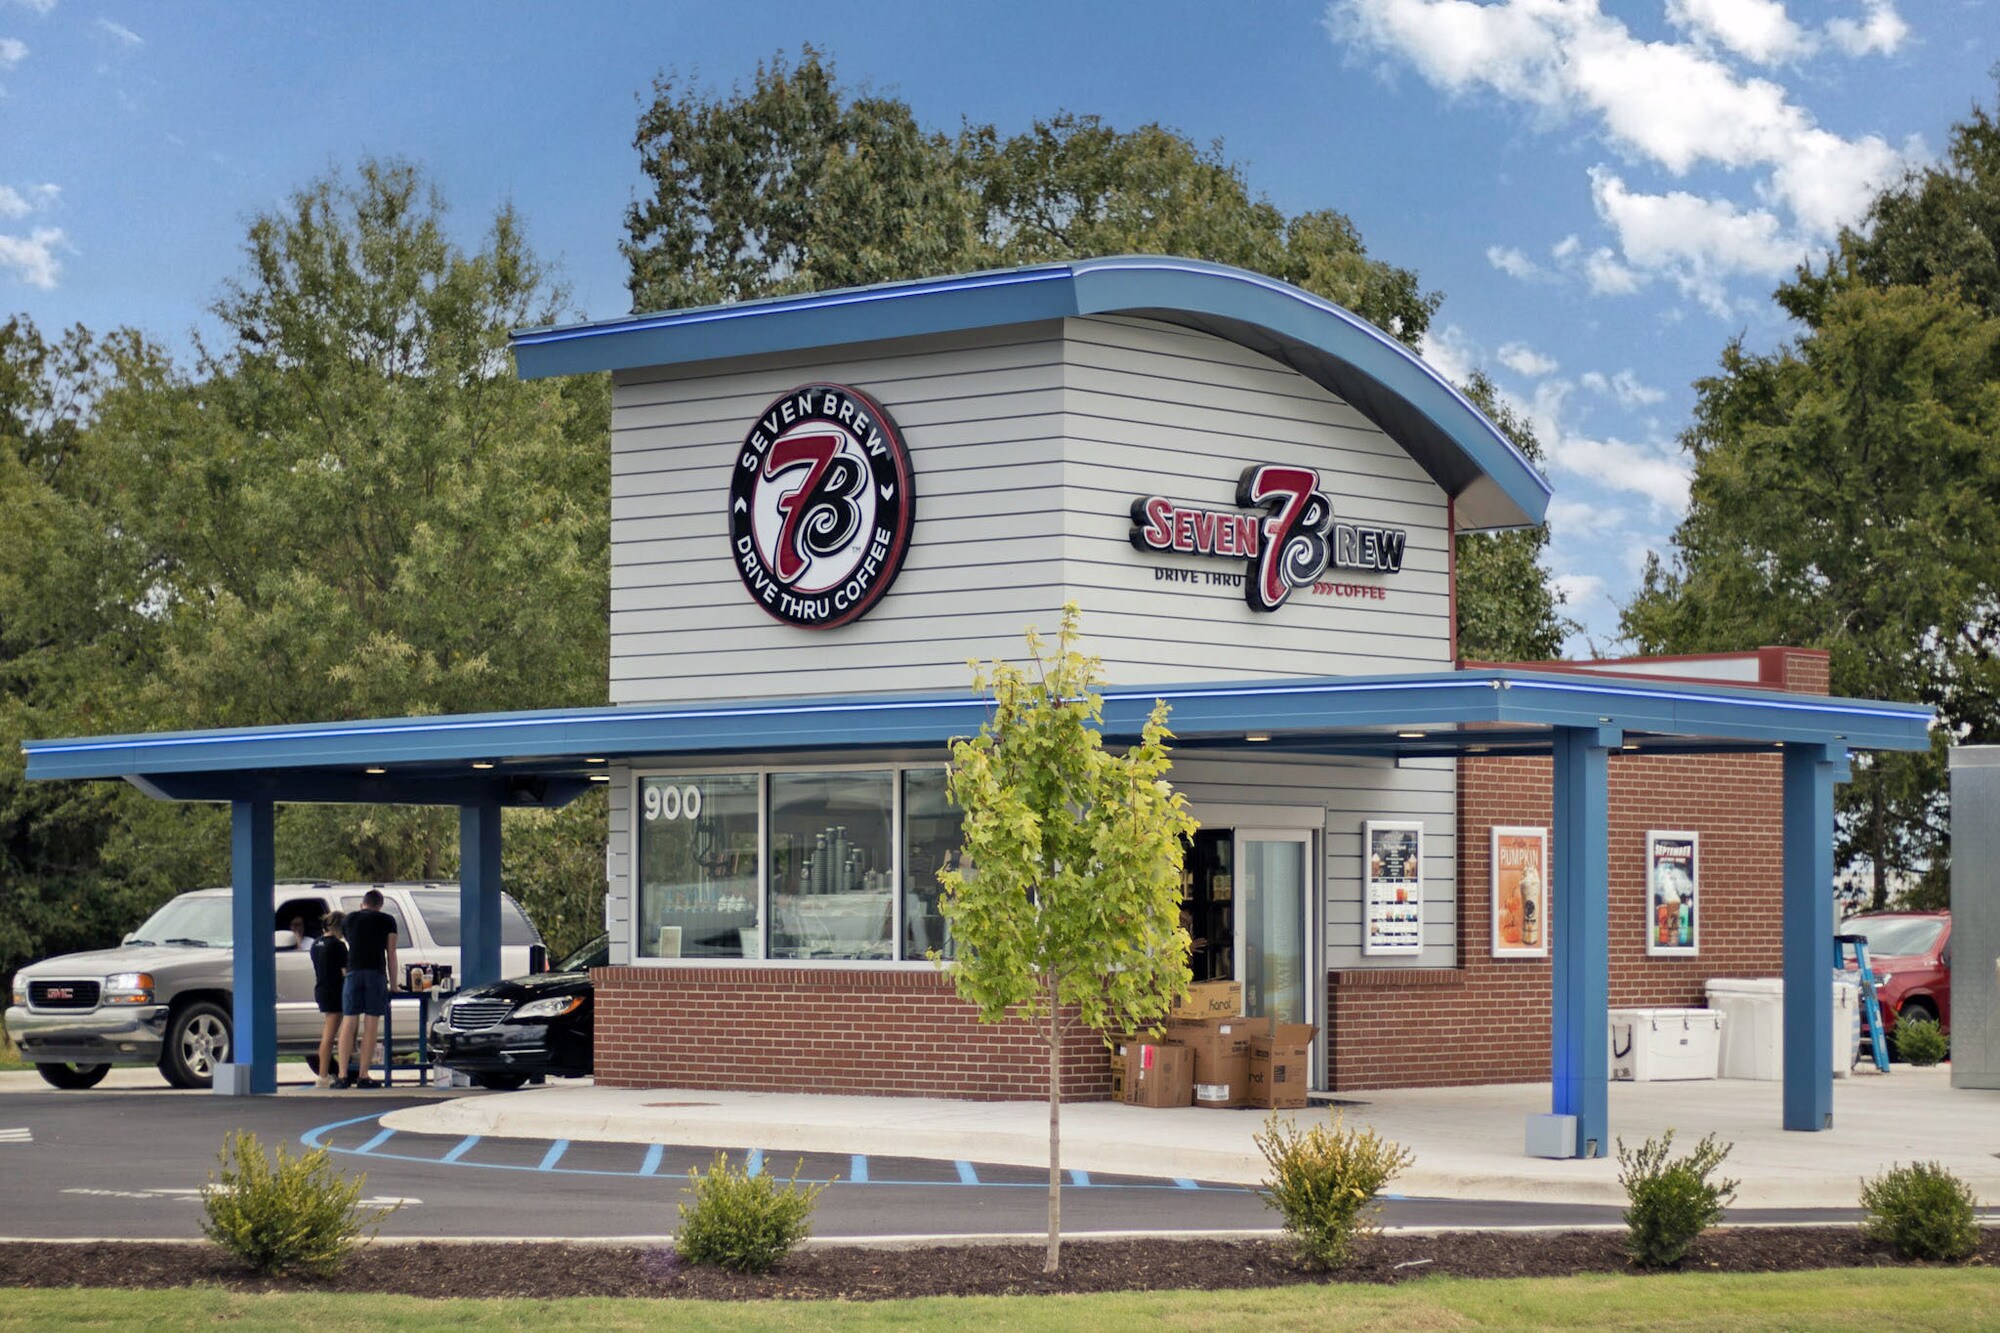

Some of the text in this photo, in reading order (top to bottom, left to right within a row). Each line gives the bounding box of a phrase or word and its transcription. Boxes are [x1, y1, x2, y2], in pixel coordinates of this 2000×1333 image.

[742, 394, 887, 472] SEVEN BREW
[1144, 496, 1258, 558] SEVEN
[737, 527, 891, 620] DRIVE THRU COFFEE
[1155, 567, 1241, 587] DRIVE THRU
[1335, 583, 1386, 600] COFFEE
[644, 784, 701, 820] 900
[1500, 849, 1539, 867] PUMPKIN
[47, 987, 74, 999] GMC
